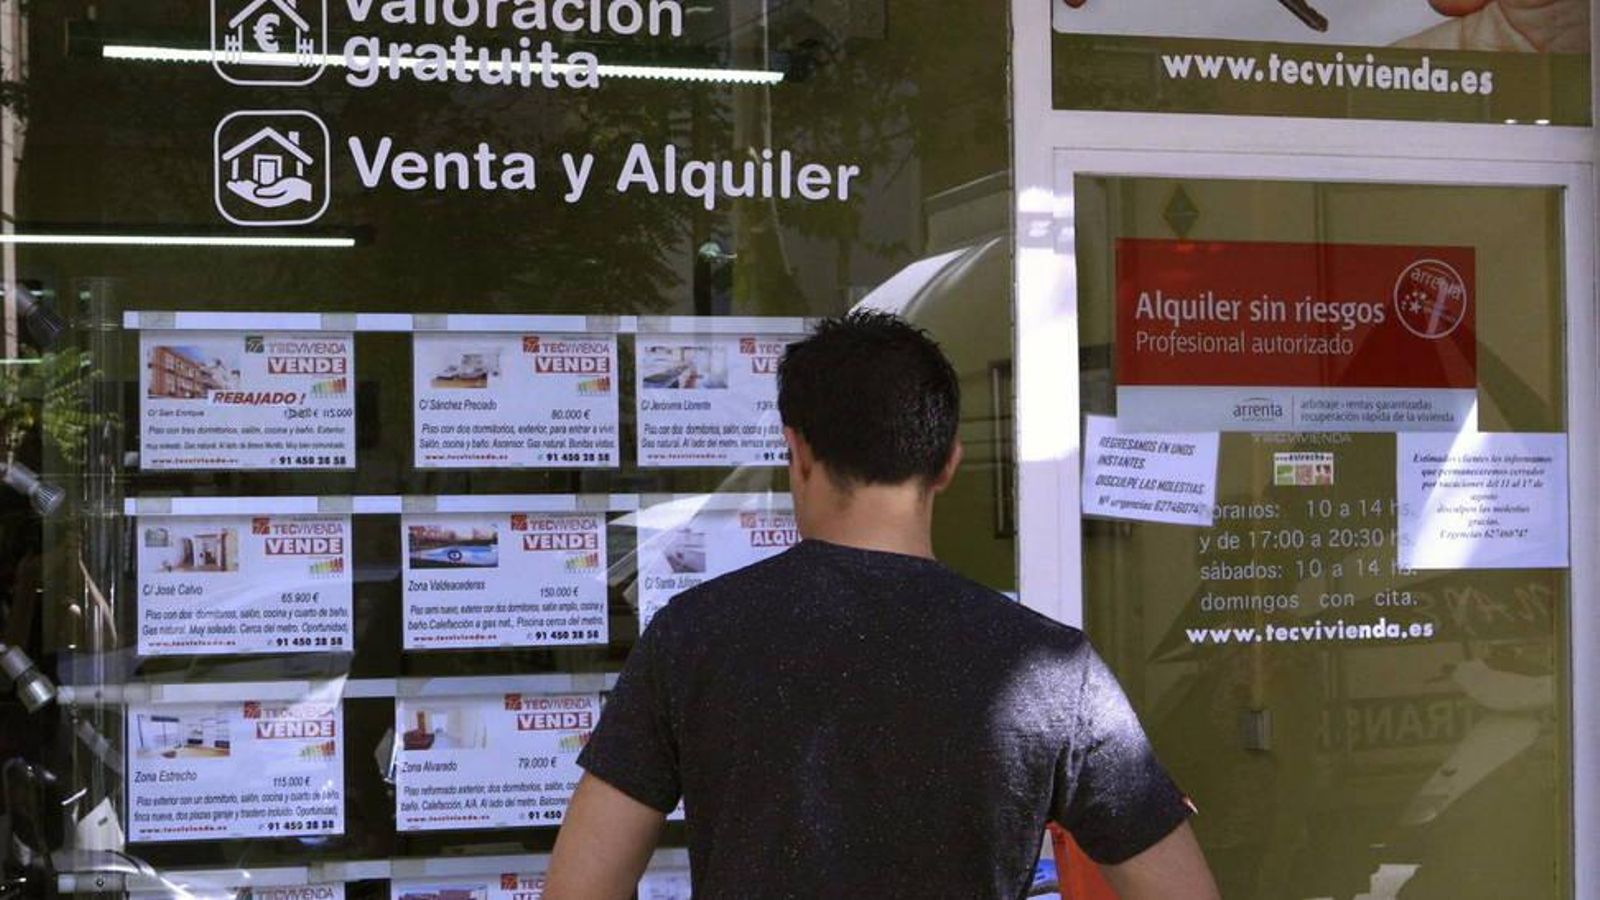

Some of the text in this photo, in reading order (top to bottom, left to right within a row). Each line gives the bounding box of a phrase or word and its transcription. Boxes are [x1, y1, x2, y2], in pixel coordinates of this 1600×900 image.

[343, 35, 600, 88] gratuita
[1161, 51, 1494, 96] www.tecvivienda.es
[348, 136, 861, 210] Venta y Alquiler
[1135, 291, 1385, 330] Alquiler sin riesgos
[1136, 330, 1354, 356] Profesional autorizado
[271, 357, 344, 373] VENDE
[538, 357, 608, 372] VENDE
[212, 392, 307, 405] REBAJADO !
[1232, 403, 1283, 418] arrenta
[279, 456, 292, 465] 91
[1212, 503, 1280, 520] orarios:
[1307, 499, 1333, 519] 10
[1340, 503, 1351, 518] a
[1359, 499, 1383, 518] 14
[268, 538, 342, 554] VENDE
[526, 533, 596, 549] VENDE
[1199, 535, 1211, 553] y
[1217, 531, 1241, 550] de
[1249, 529, 1305, 550] 17:00
[1311, 533, 1321, 549] a
[1328, 528, 1385, 548] 20:30
[1200, 559, 1283, 580] sábados:
[1296, 558, 1322, 579] 10
[1332, 563, 1343, 578] a
[1357, 558, 1380, 577] 14
[155, 583, 177, 597] José
[178, 583, 203, 596] Calvo
[1200, 591, 1300, 614] domingos
[1319, 592, 1356, 609] con
[1374, 588, 1419, 608] cita.
[535, 631, 548, 640] 91
[550, 631, 570, 640] 450
[1186, 617, 1434, 644] www.tecvivienda.es
[276, 637, 289, 647] 91
[292, 637, 313, 647] 450
[520, 713, 590, 729] VENDE
[260, 721, 332, 738] VENDE
